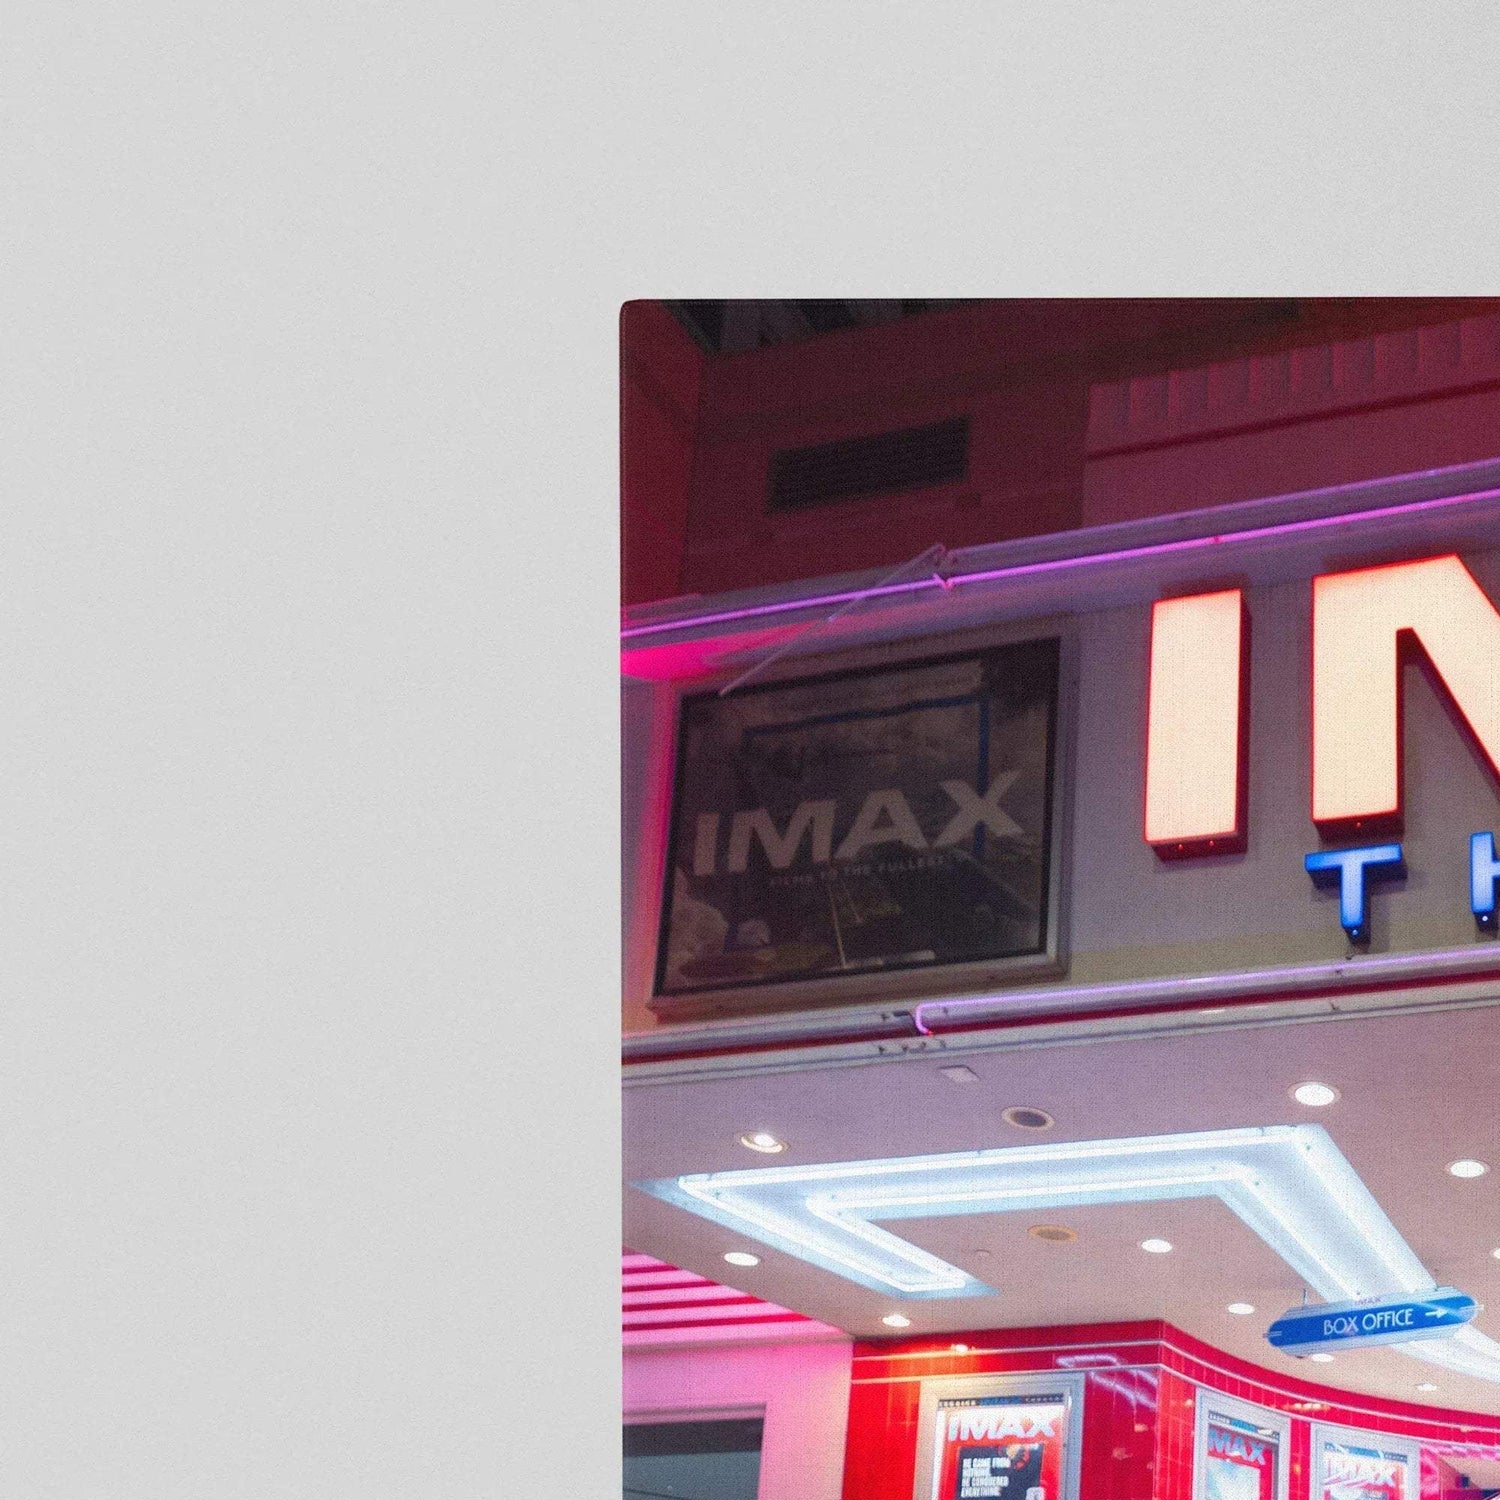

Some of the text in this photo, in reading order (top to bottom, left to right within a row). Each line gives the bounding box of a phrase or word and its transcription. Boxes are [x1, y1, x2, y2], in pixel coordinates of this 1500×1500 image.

[693, 769, 1026, 877] IMAX
[1323, 1308, 1413, 1335] BOX OFFICE
[947, 1412, 1059, 1442] IMAX
